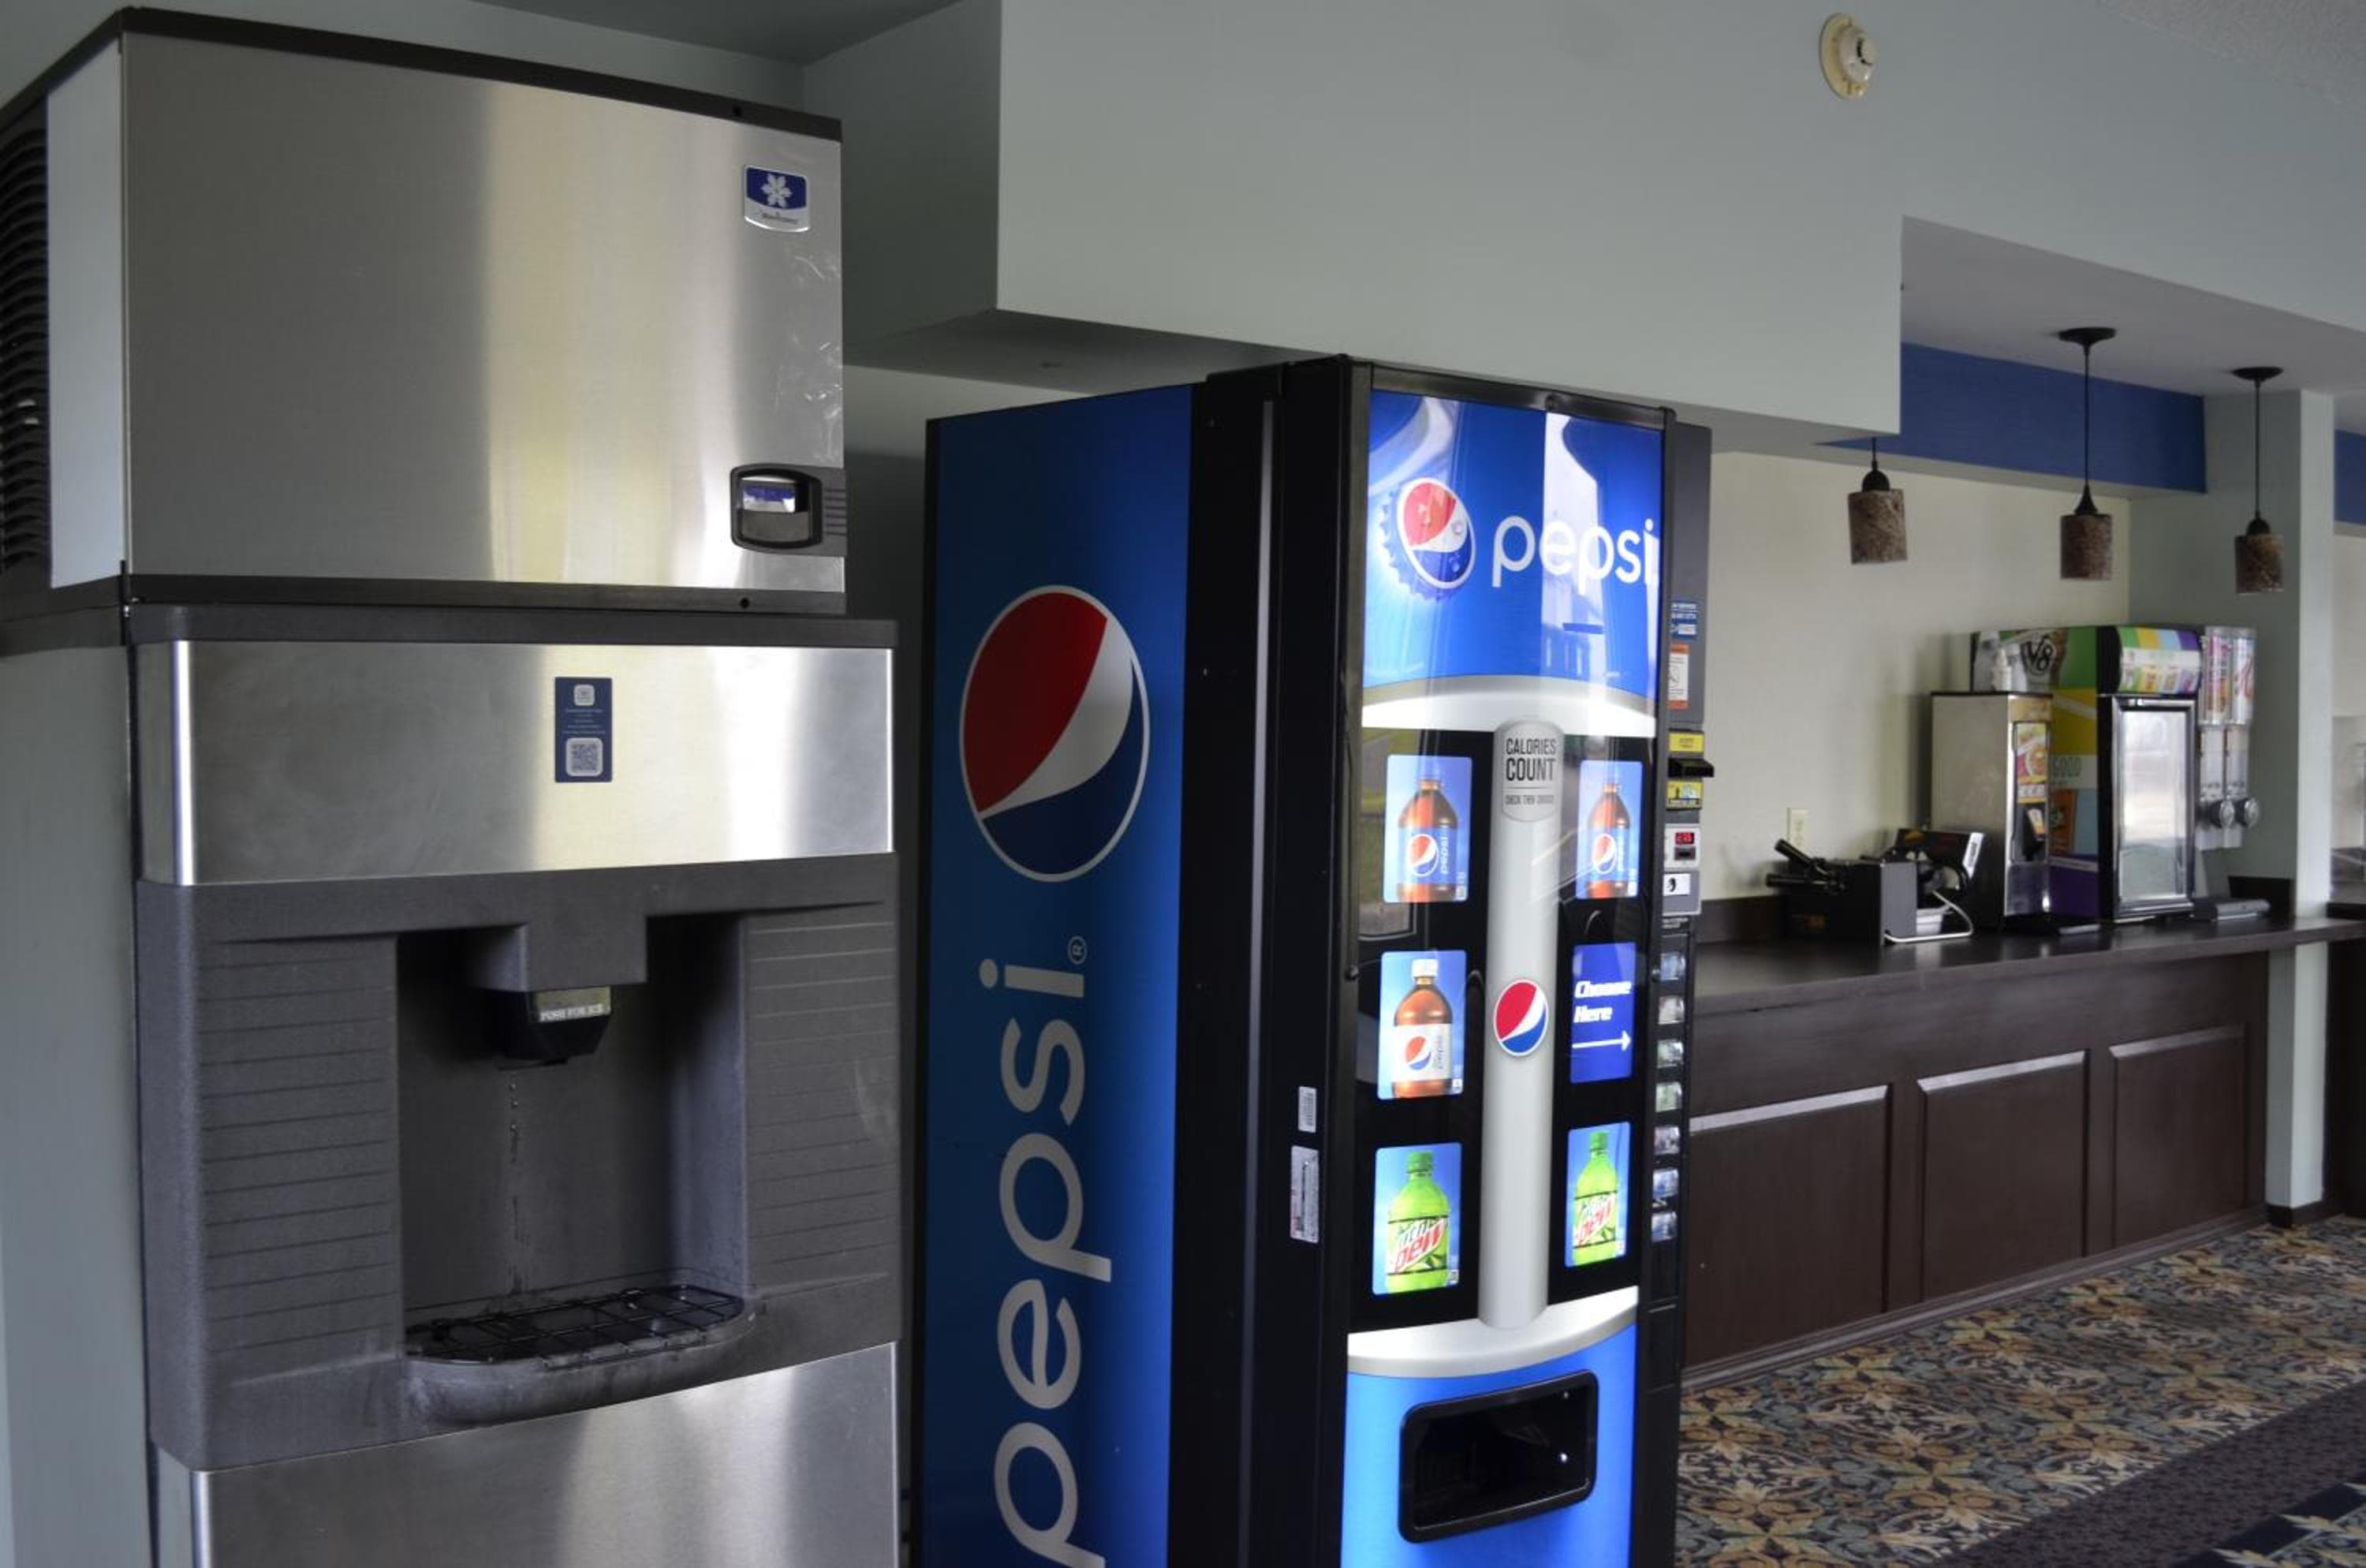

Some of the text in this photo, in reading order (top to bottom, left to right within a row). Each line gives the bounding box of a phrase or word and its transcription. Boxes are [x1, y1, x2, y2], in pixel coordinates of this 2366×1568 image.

[1491, 515, 1655, 596] pepsi
[1505, 737, 1558, 755] CALORIES
[1506, 758, 1557, 782] COUNT
[1573, 1004, 1614, 1024] Here
